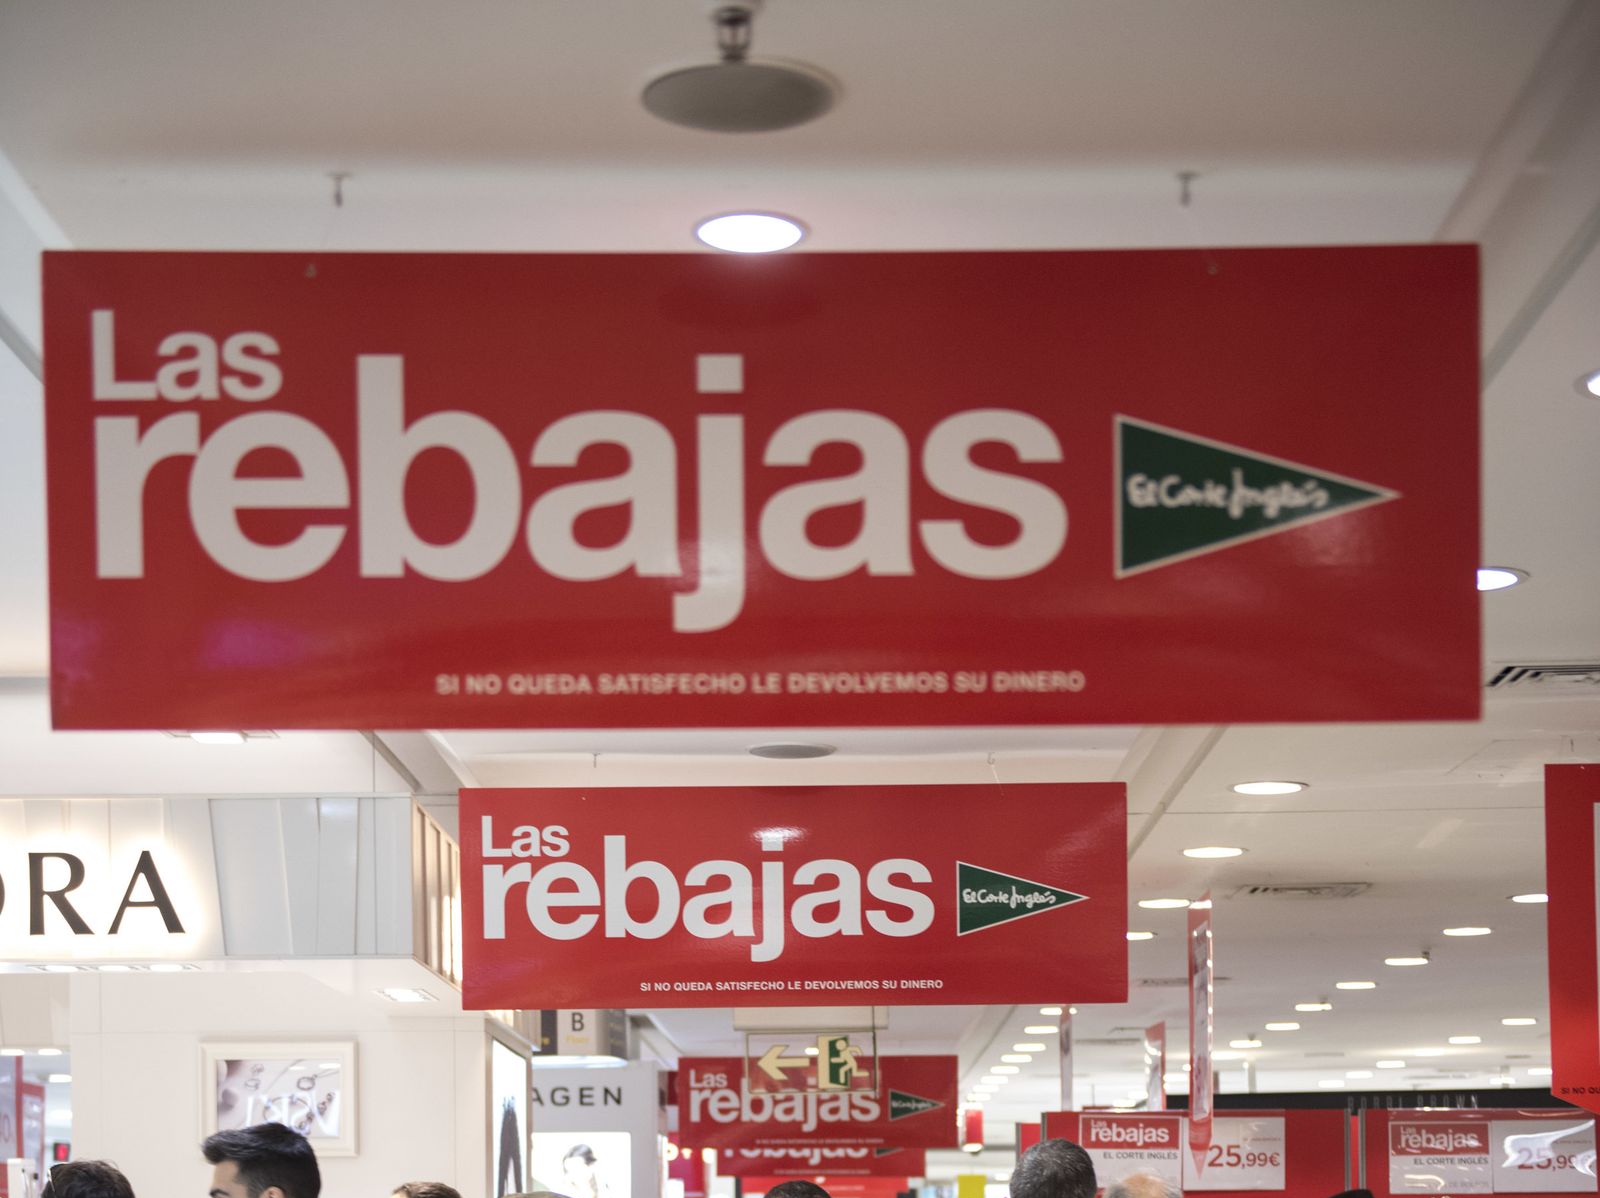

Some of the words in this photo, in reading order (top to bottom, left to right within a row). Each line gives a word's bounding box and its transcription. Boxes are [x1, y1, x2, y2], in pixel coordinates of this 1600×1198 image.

[92, 309, 283, 402] Las
[95, 353, 1069, 633] rebajas
[436, 673, 459, 695] SI
[465, 673, 502, 695] NO
[507, 673, 592, 695] QUEDA
[598, 672, 747, 695] SATISFECHO
[752, 672, 782, 694] LE
[787, 671, 949, 694] DEVOLVEMOS
[953, 671, 987, 693] SU
[992, 670, 1086, 693] DINERO
[481, 815, 570, 858] Las
[0, 850, 186, 935] RA
[483, 835, 935, 962] rebajas
[962, 888, 977, 903] El
[977, 889, 1009, 903] Corte
[1009, 885, 1056, 909] Inglés
[640, 982, 651, 991] SI
[654, 982, 671, 991] NO
[674, 982, 713, 991] QUEDA
[716, 981, 785, 991] SATISFECHO
[788, 981, 801, 990] LE
[804, 980, 879, 990] DEVOLVEMOS
[882, 980, 897, 989] SU
[900, 980, 943, 989] DINERO
[571, 1012, 585, 1032] B
[690, 1070, 727, 1088] Las
[689, 1078, 880, 1132] rebajas
[1091, 1123, 1169, 1146] rebajas
[1400, 1129, 1480, 1152] rebajas
[1208, 1145, 1280, 1169] 25,99€
[1426, 1157, 1455, 1165] CORTE
